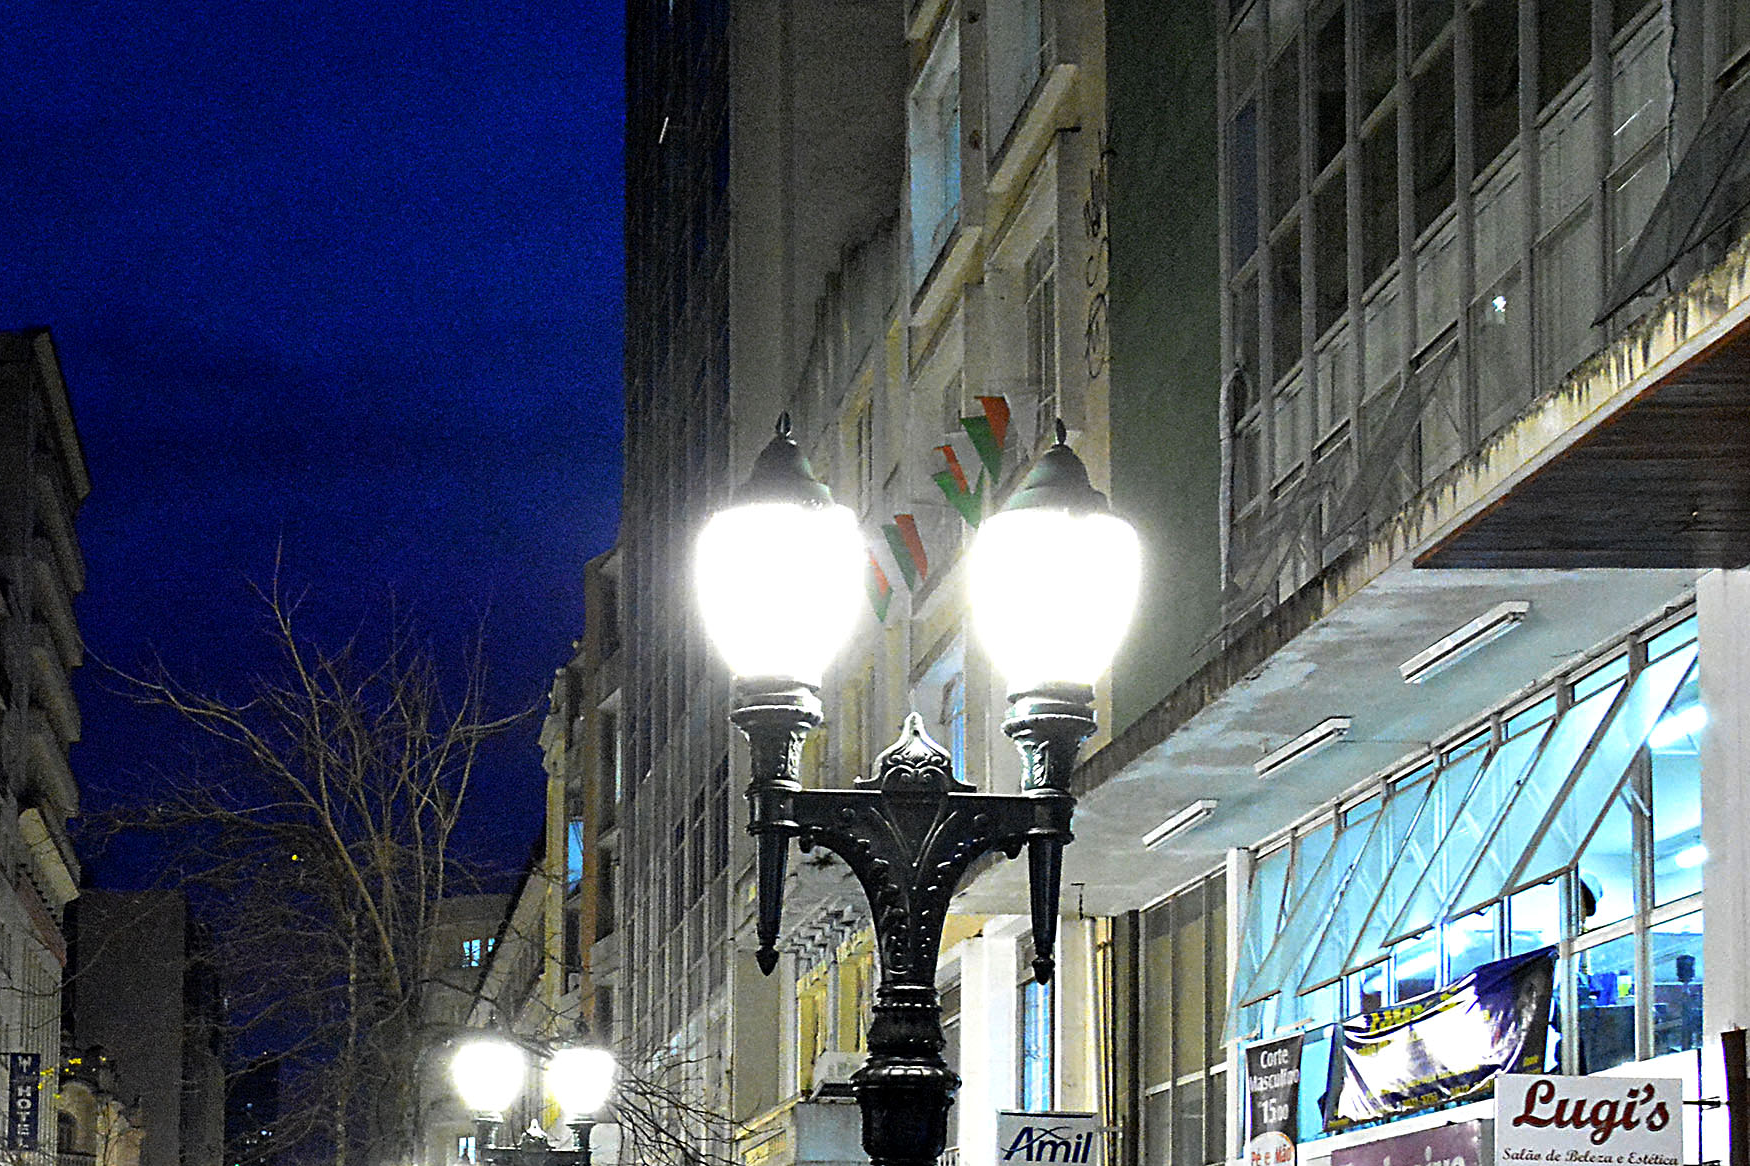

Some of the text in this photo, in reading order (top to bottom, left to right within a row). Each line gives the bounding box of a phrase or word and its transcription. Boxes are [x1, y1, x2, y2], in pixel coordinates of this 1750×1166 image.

[1260, 1048, 1289, 1068] Corte
[1250, 1068, 1299, 1092] Masculino
[1513, 1079, 1670, 1145] Lugi's
[1002, 1126, 1093, 1164] Amil
[1502, 1147, 1679, 1166] Salão de Beleza e Estética
